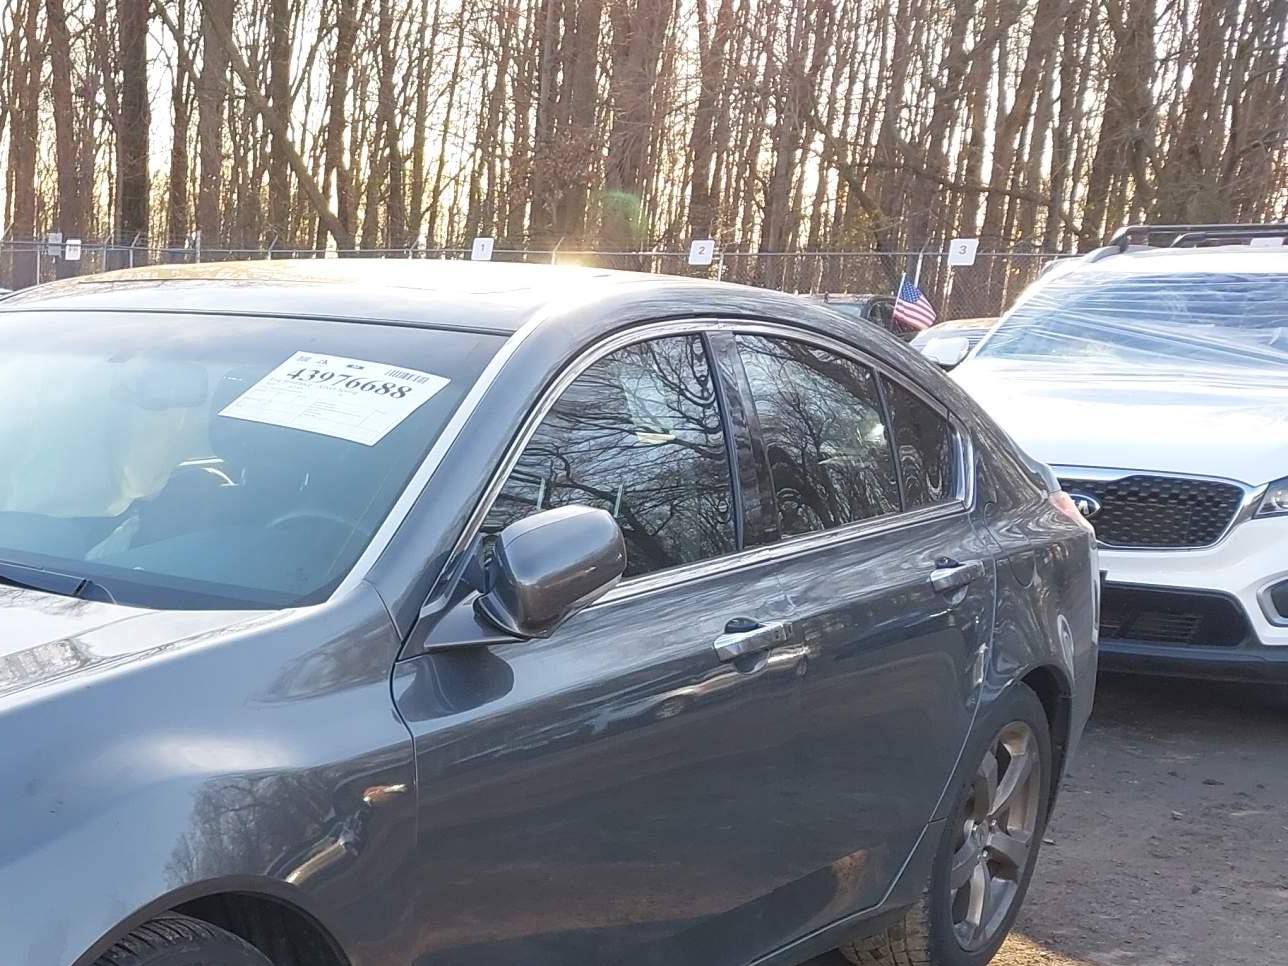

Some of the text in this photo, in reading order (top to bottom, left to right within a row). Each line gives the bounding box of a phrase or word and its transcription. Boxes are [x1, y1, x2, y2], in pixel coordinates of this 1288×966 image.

[698, 246, 706, 255] 2
[959, 245, 968, 255] 3
[286, 367, 413, 399] 43976688
